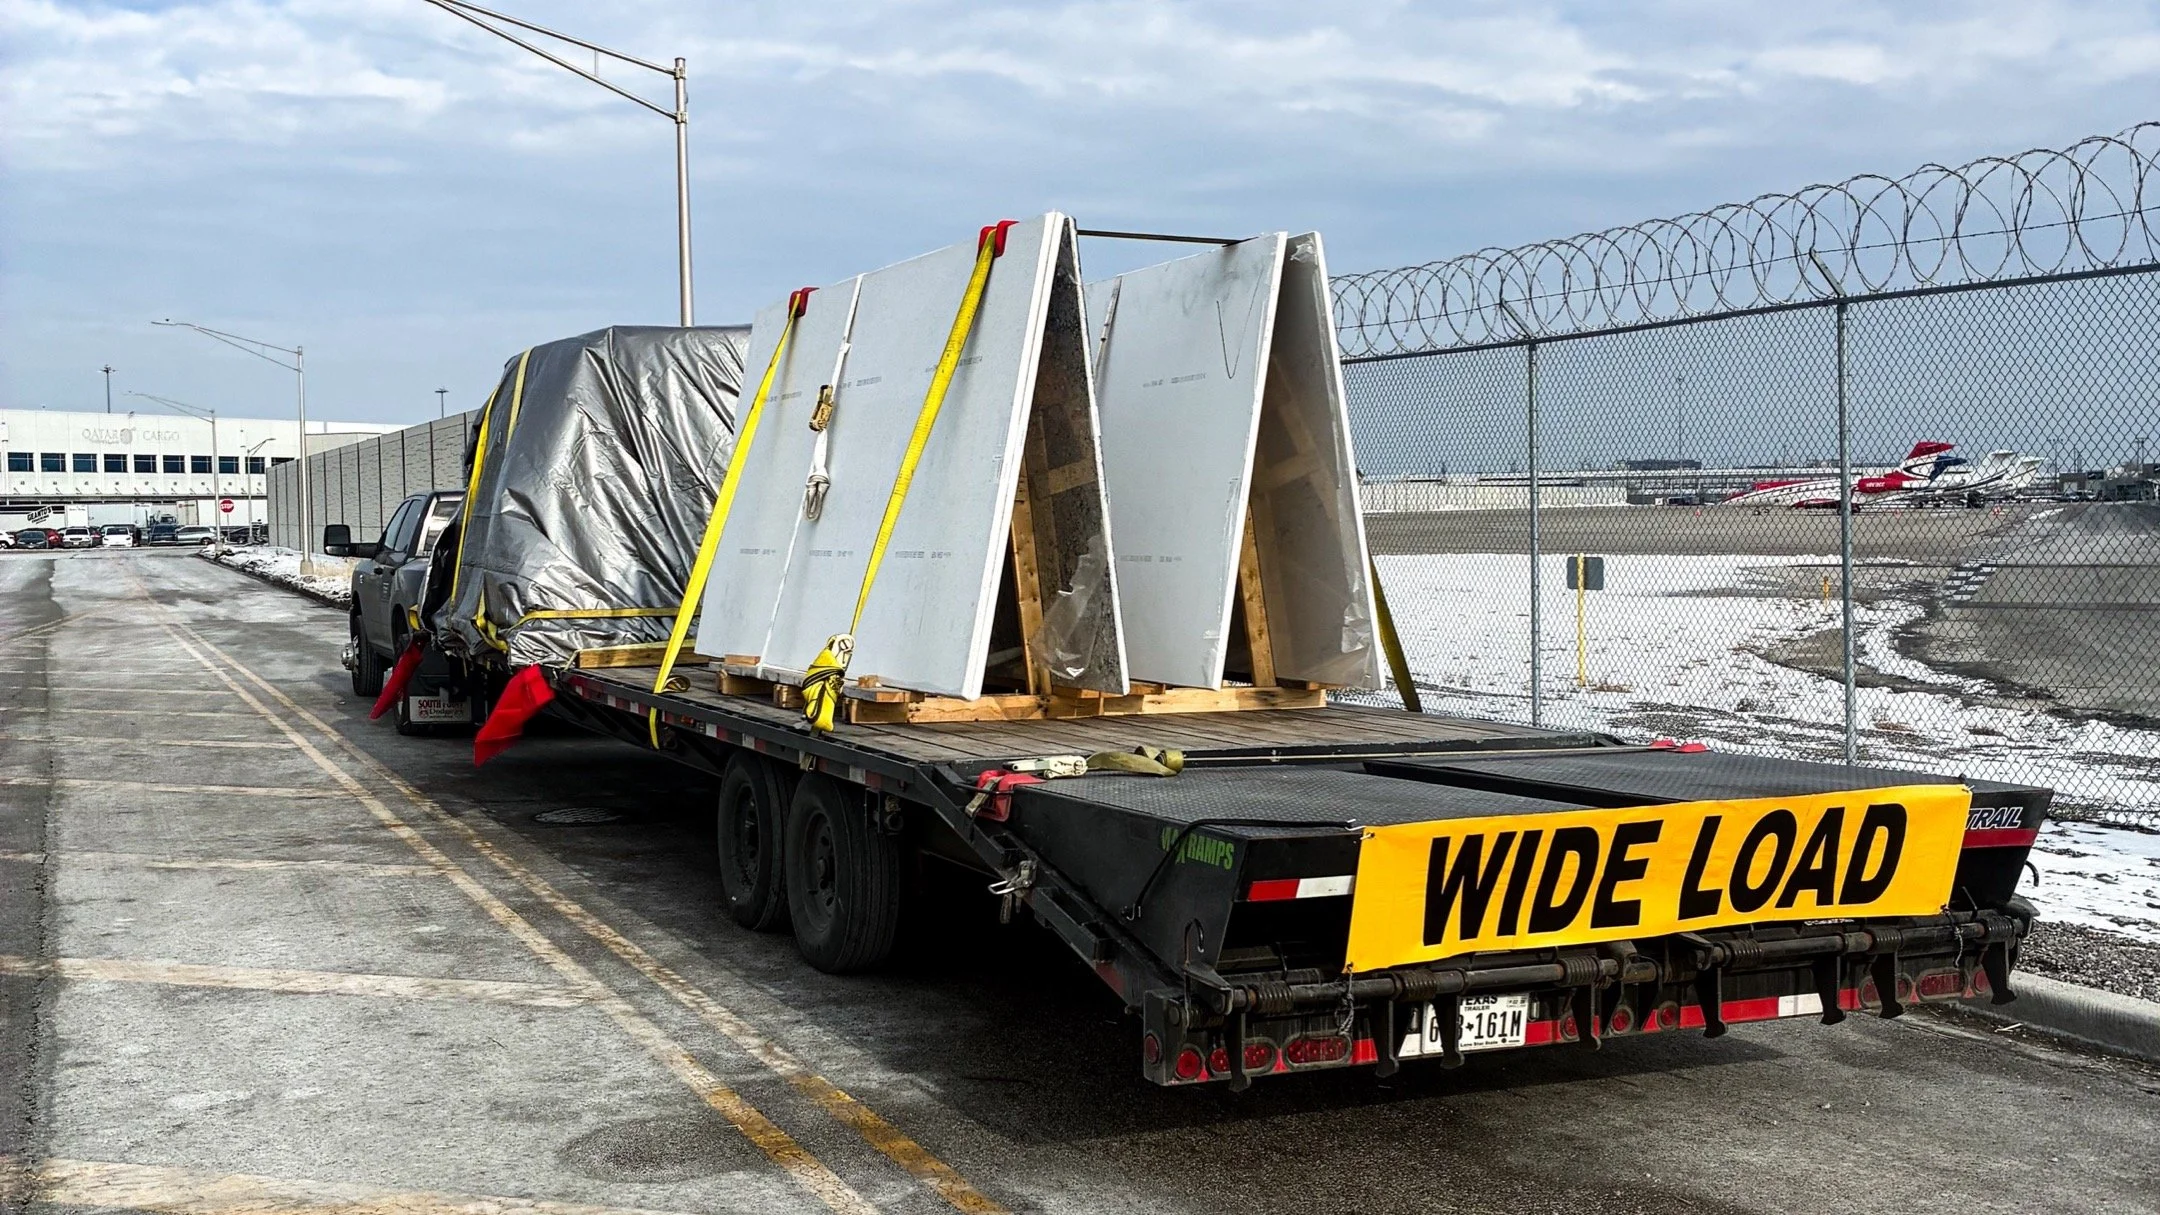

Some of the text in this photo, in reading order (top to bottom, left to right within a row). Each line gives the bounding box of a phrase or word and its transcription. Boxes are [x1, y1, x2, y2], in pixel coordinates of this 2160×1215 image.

[142, 430, 180, 441] CARGO
[418, 699, 441, 708] SOUTH
[1187, 832, 1235, 870] RAMPS
[1423, 802, 1908, 946] WIDE LOAD
